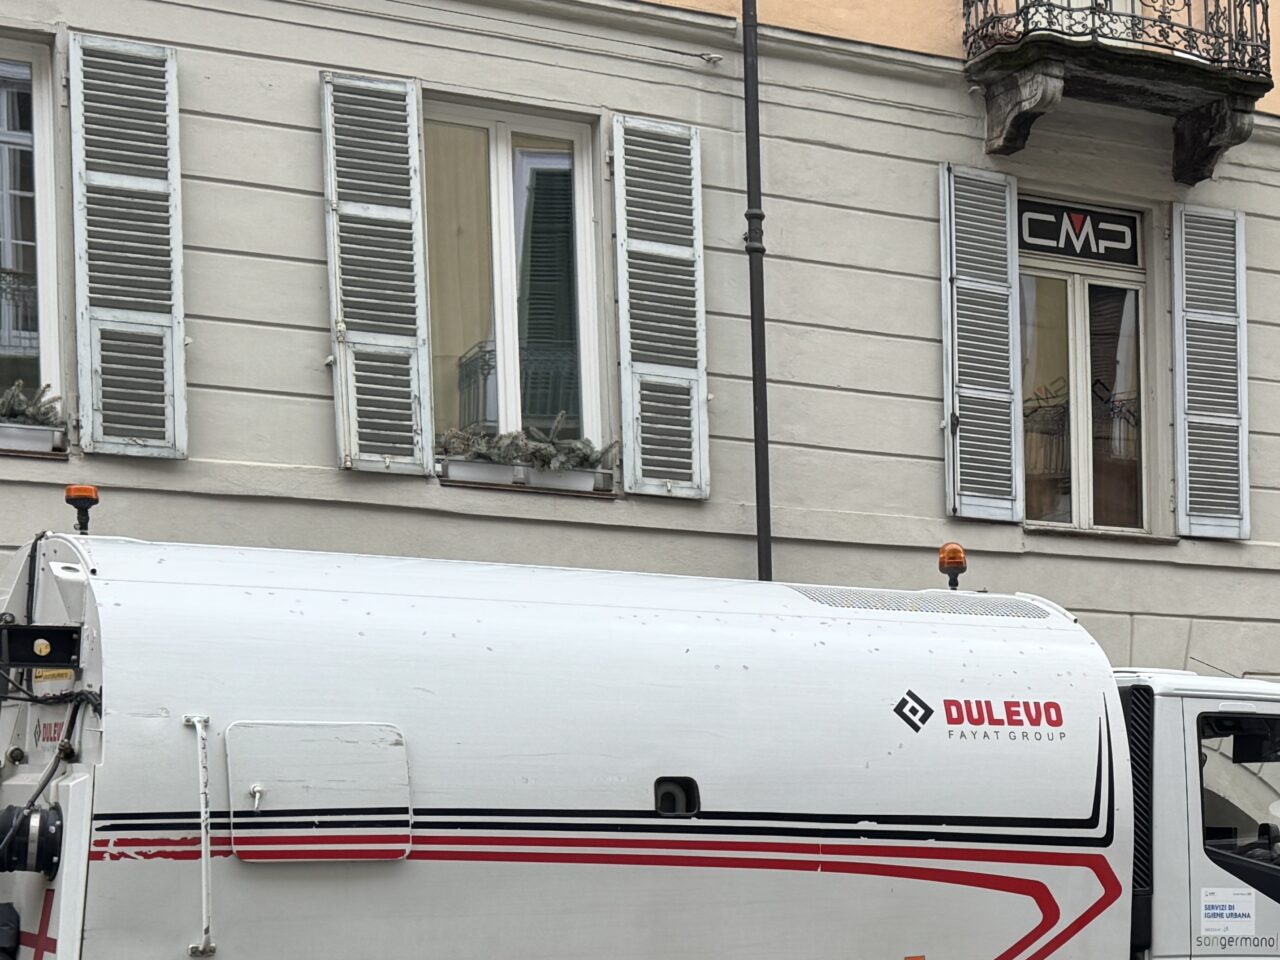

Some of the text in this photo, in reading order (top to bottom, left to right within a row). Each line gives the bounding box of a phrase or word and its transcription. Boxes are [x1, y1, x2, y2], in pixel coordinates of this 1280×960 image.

[1021, 211, 1132, 254] CMP
[943, 699, 1063, 728] DULEVO
[948, 730, 1067, 742] FAYAT GROUP
[1196, 936, 1275, 950] sangermano
